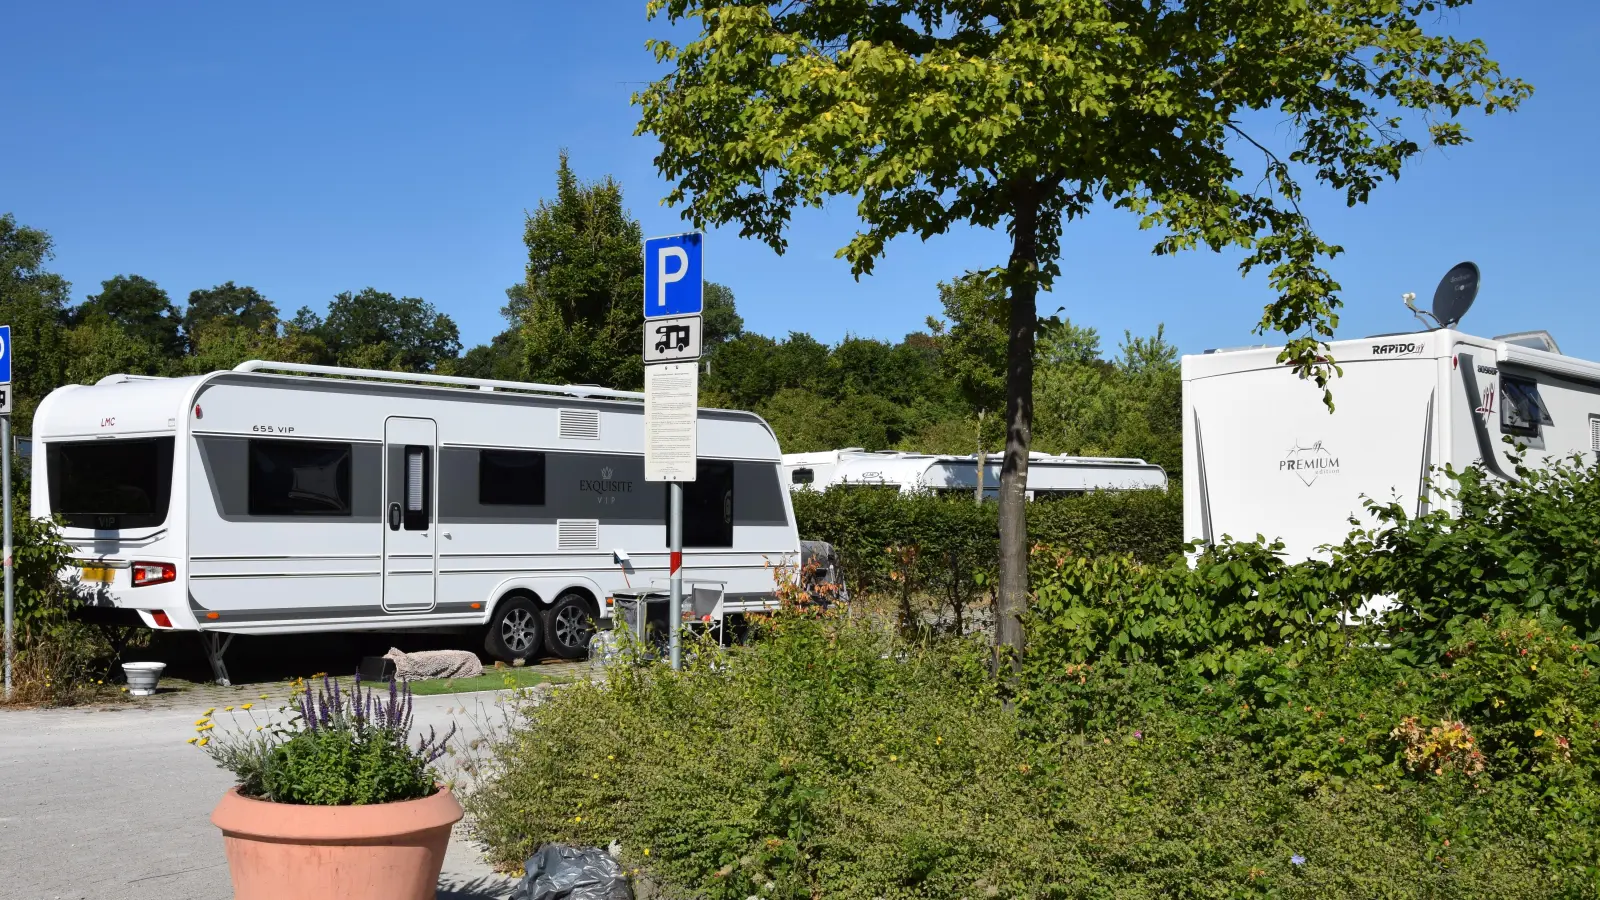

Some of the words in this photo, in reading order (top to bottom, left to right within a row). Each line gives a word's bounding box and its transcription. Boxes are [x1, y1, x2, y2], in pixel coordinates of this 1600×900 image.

[658, 246, 689, 307] P
[100, 417, 116, 427] LMC
[252, 425, 274, 433] 655
[1279, 457, 1339, 471] PREMIUM
[579, 479, 633, 494] EXQUISITE
[597, 496, 616, 504] VIP
[98, 516, 115, 528] VIP
